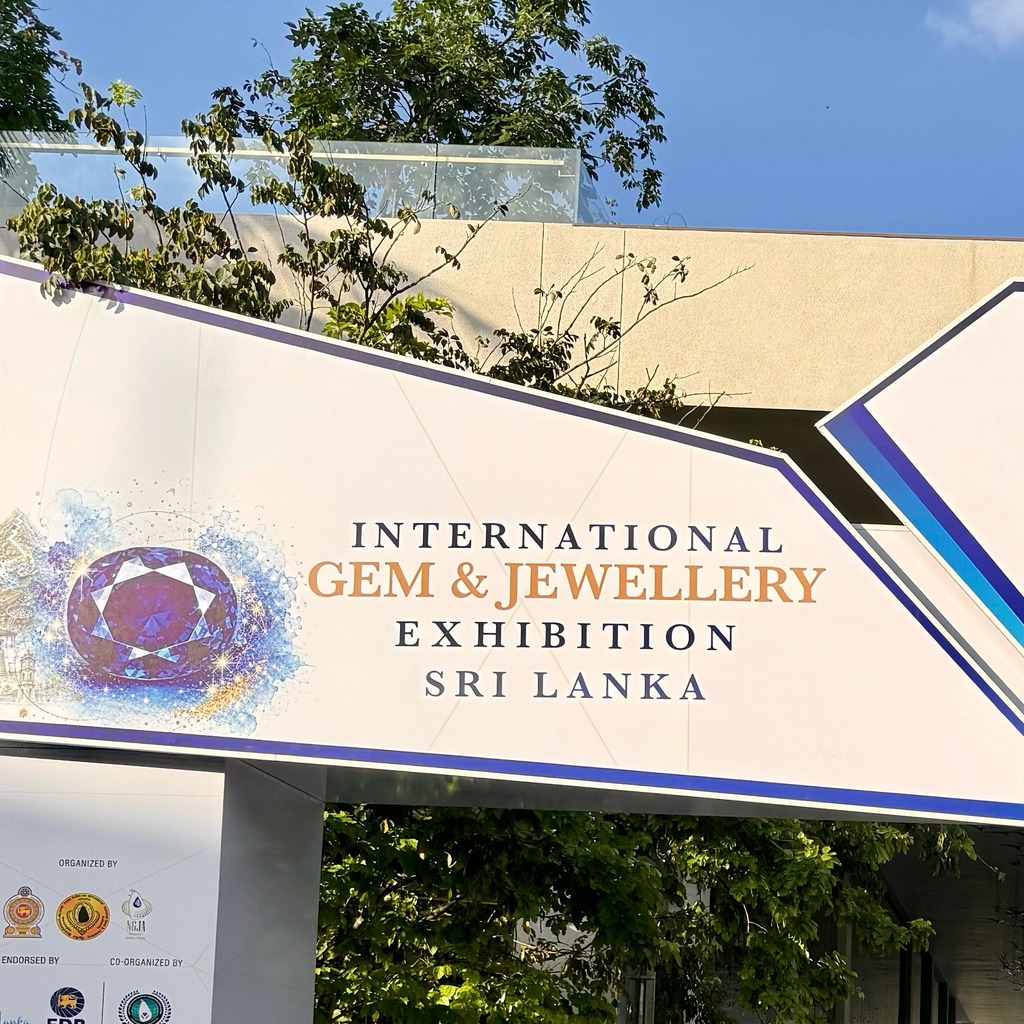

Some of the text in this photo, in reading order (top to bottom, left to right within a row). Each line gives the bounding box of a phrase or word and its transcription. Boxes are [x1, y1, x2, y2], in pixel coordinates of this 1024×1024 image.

[351, 521, 784, 554] INTERNATIONAL
[307, 561, 827, 611] GEM & JEWELLERY
[394, 620, 736, 652] EXHIBITION
[424, 669, 706, 701] SRI LANKA
[58, 858, 118, 868] ORGANIZED BY
[1, 956, 59, 965] ENDORSED BY
[109, 958, 183, 968] CO-ORGANIZED BY
